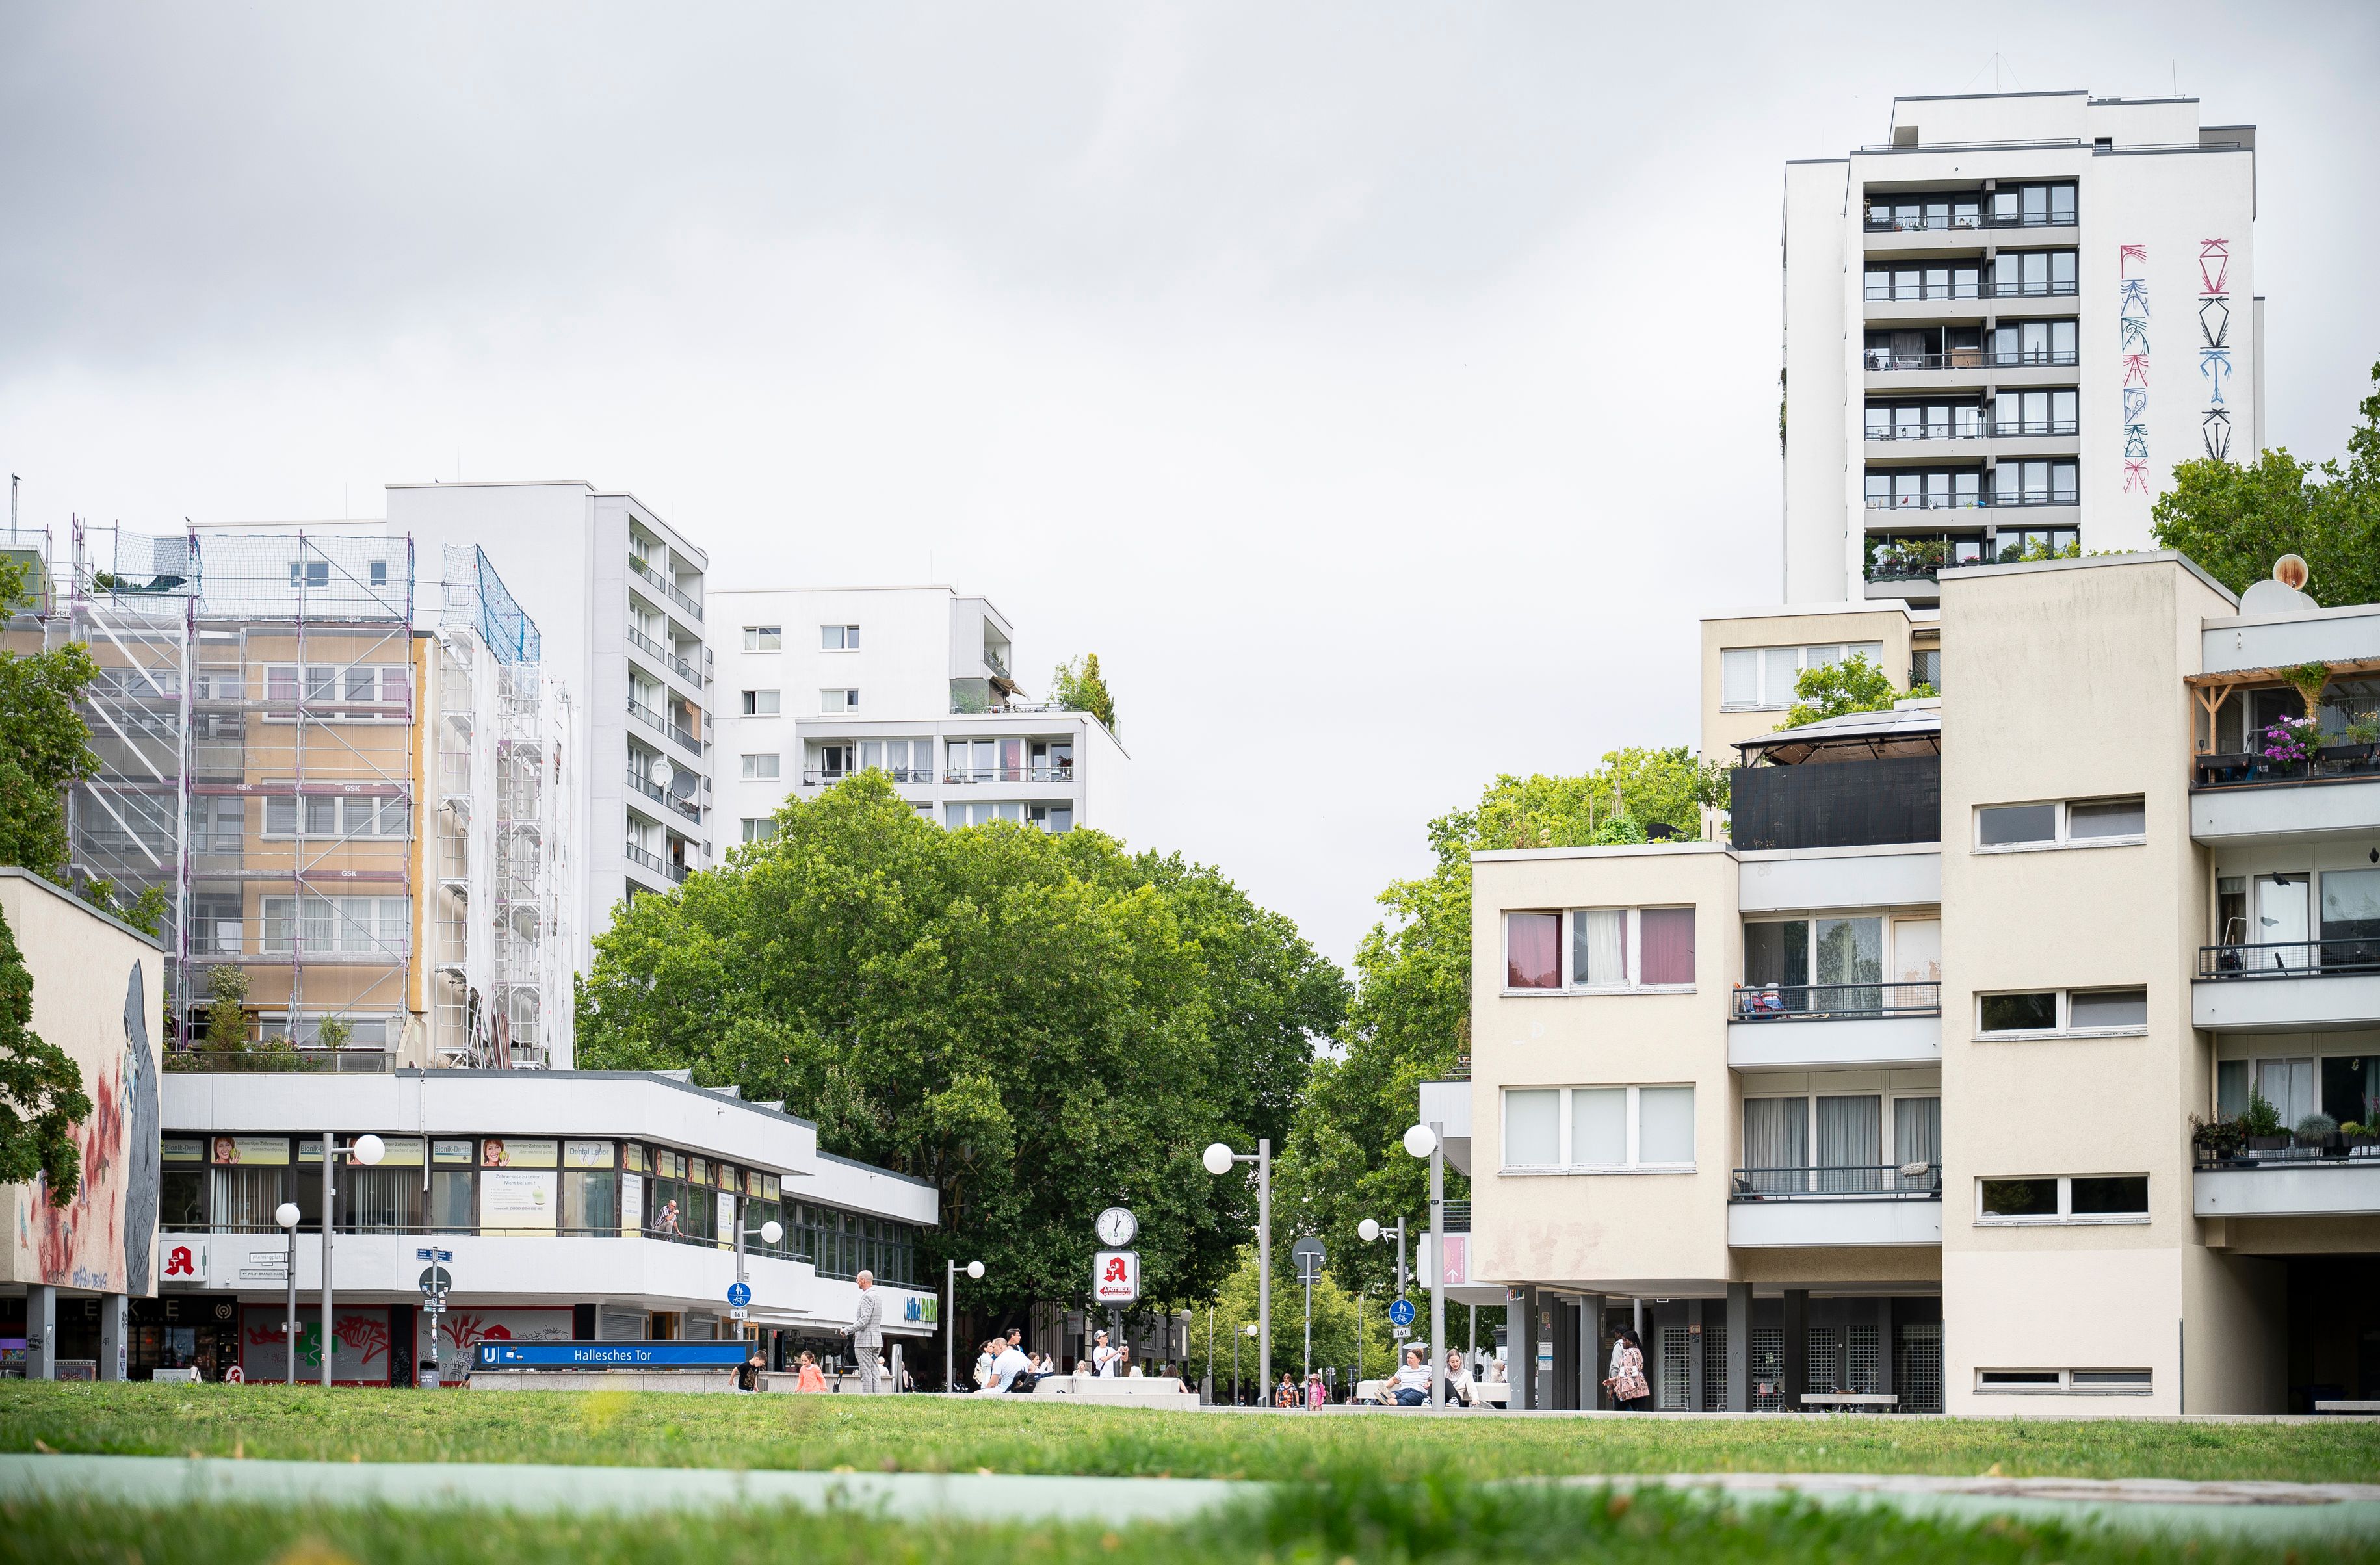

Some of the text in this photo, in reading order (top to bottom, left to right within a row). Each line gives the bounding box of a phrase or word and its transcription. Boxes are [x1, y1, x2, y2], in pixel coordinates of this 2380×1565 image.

[434, 1145, 471, 1153] Bionik-Dental
[569, 1147, 590, 1156] Dental
[484, 1347, 496, 1362] U
[575, 1349, 652, 1362] Hallesches Tor
